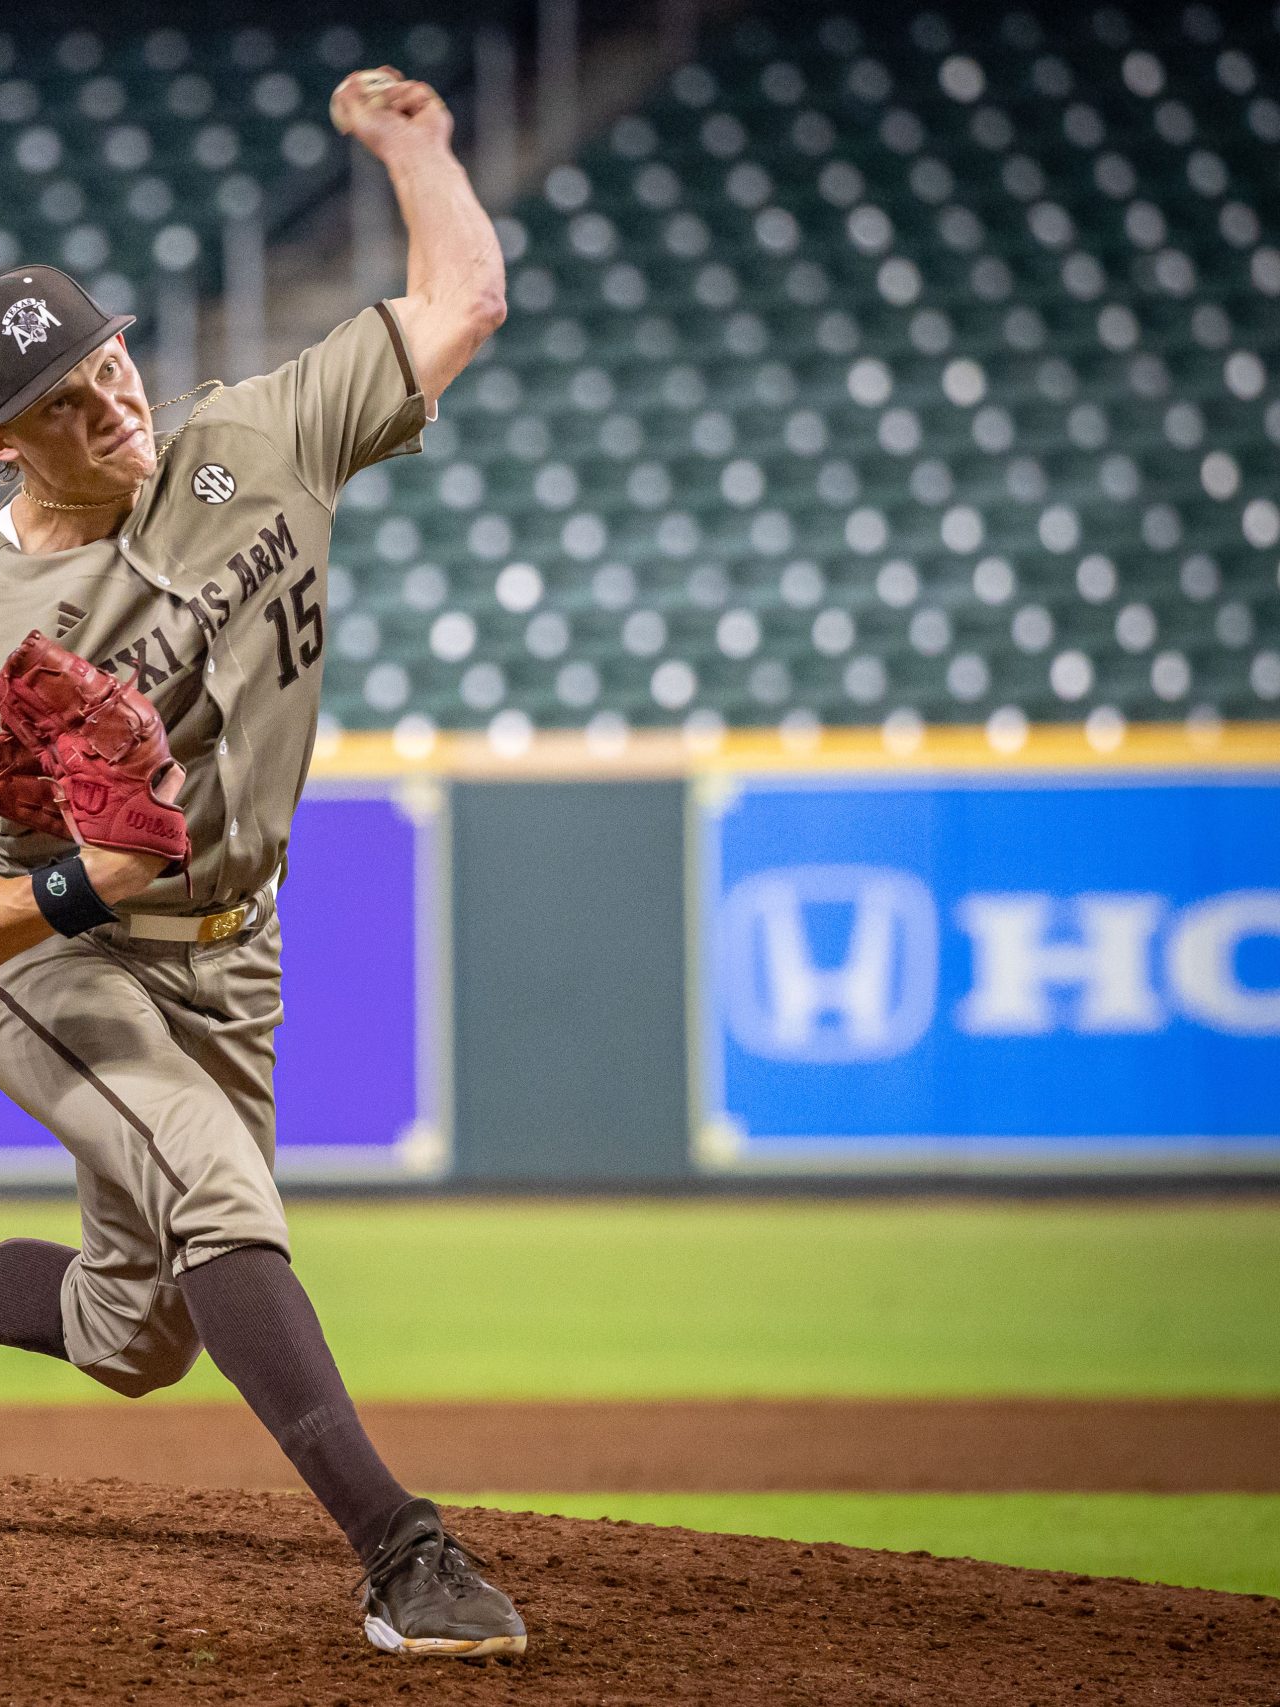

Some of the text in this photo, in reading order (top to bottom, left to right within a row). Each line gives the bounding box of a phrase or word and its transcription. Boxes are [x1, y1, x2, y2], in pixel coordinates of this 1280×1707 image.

[4, 298, 32, 321] TEXAS
[194, 465, 235, 503] SEC
[226, 512, 299, 606] A&M
[264, 566, 323, 690] 15
